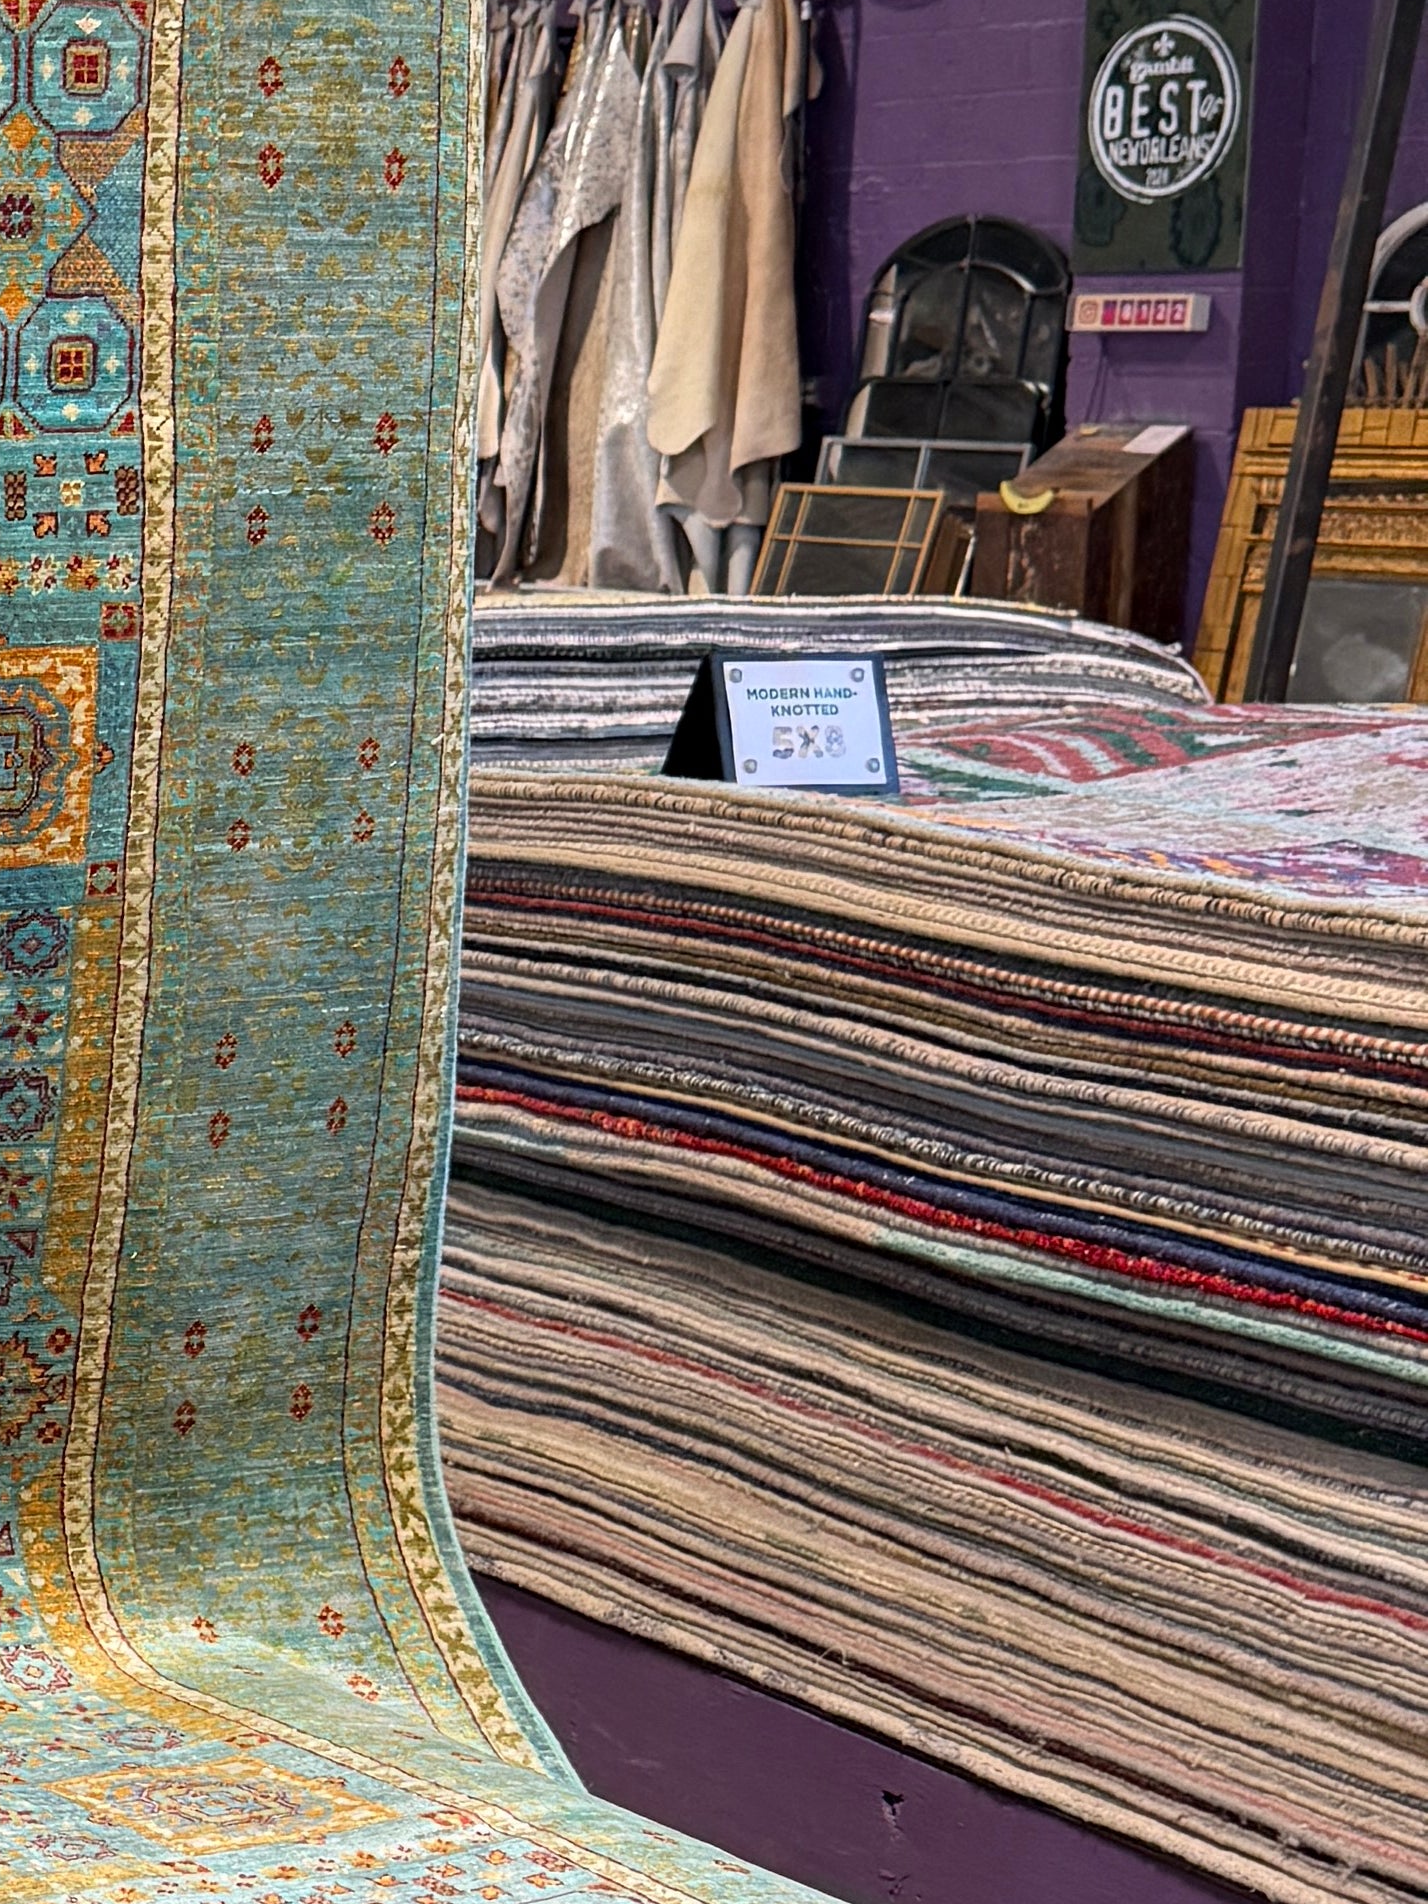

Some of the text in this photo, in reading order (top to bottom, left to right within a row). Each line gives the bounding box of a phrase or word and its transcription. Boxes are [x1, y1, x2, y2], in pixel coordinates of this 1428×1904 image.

[1103, 79, 1224, 140] BEST OF
[746, 687, 858, 700] MODERN HAND-
[770, 703, 839, 717] KNOTTED
